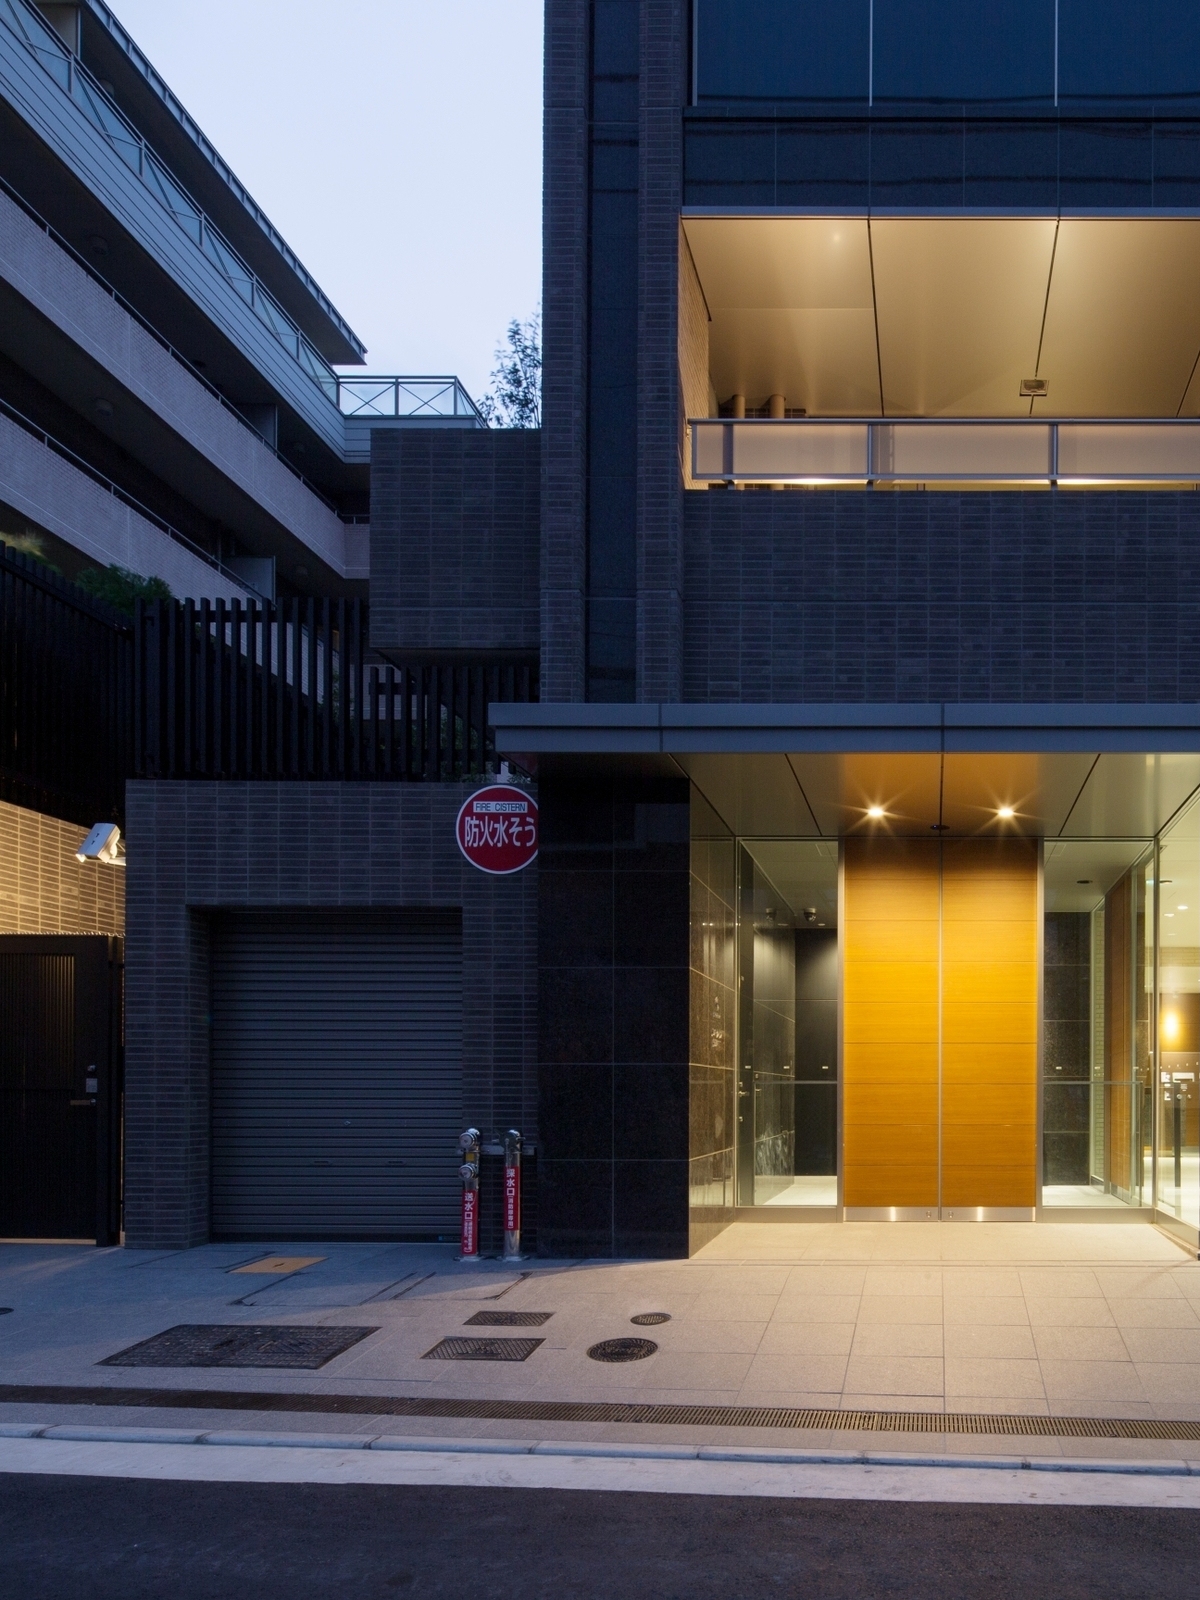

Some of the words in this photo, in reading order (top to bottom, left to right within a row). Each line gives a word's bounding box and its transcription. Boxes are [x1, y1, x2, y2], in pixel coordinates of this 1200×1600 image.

[475, 803, 491, 812] FIRE
[495, 803, 526, 812] CISTERN
[464, 815, 536, 848] 防火水そう
